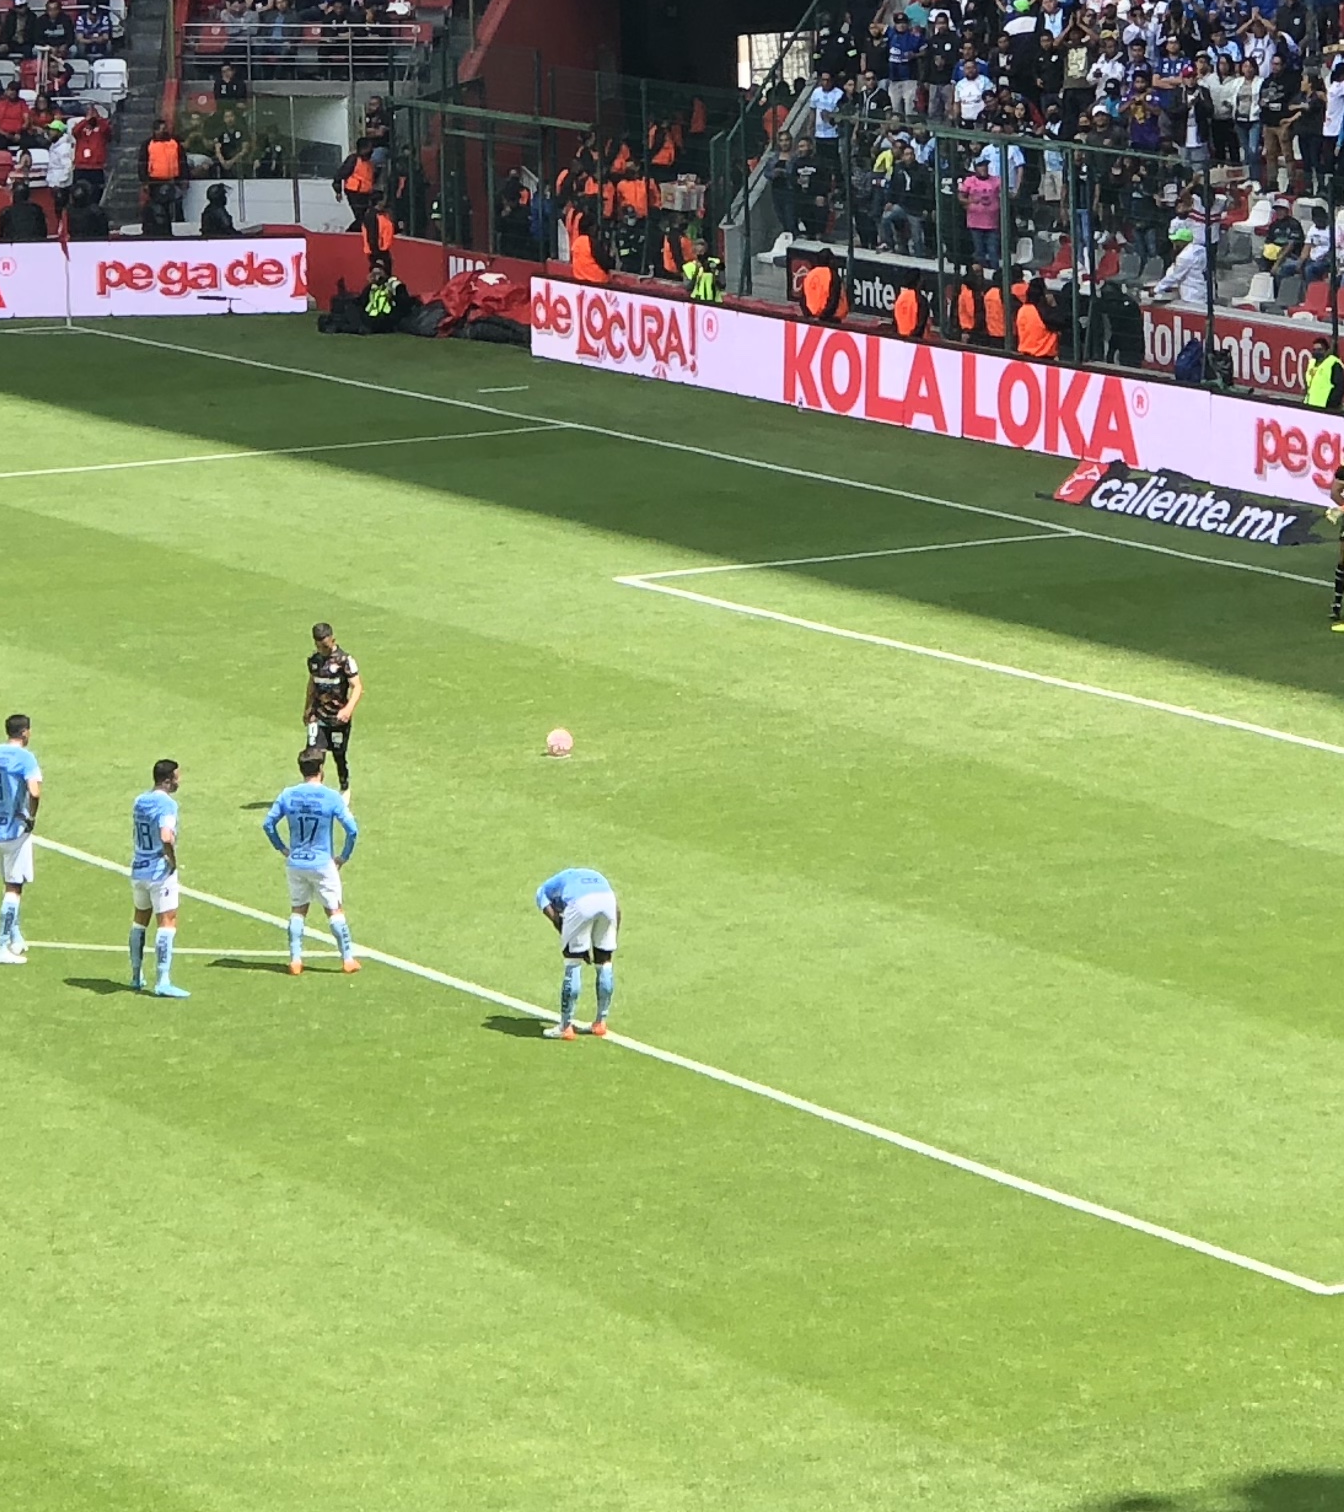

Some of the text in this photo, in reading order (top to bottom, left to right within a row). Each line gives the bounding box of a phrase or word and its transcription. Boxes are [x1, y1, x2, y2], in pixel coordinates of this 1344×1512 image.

[96, 259, 221, 295] pega
[225, 251, 286, 287] de
[531, 285, 574, 336] de
[783, 321, 948, 434] KOLA
[1090, 475, 1297, 545] caliente.mx
[297, 816, 319, 843] 17
